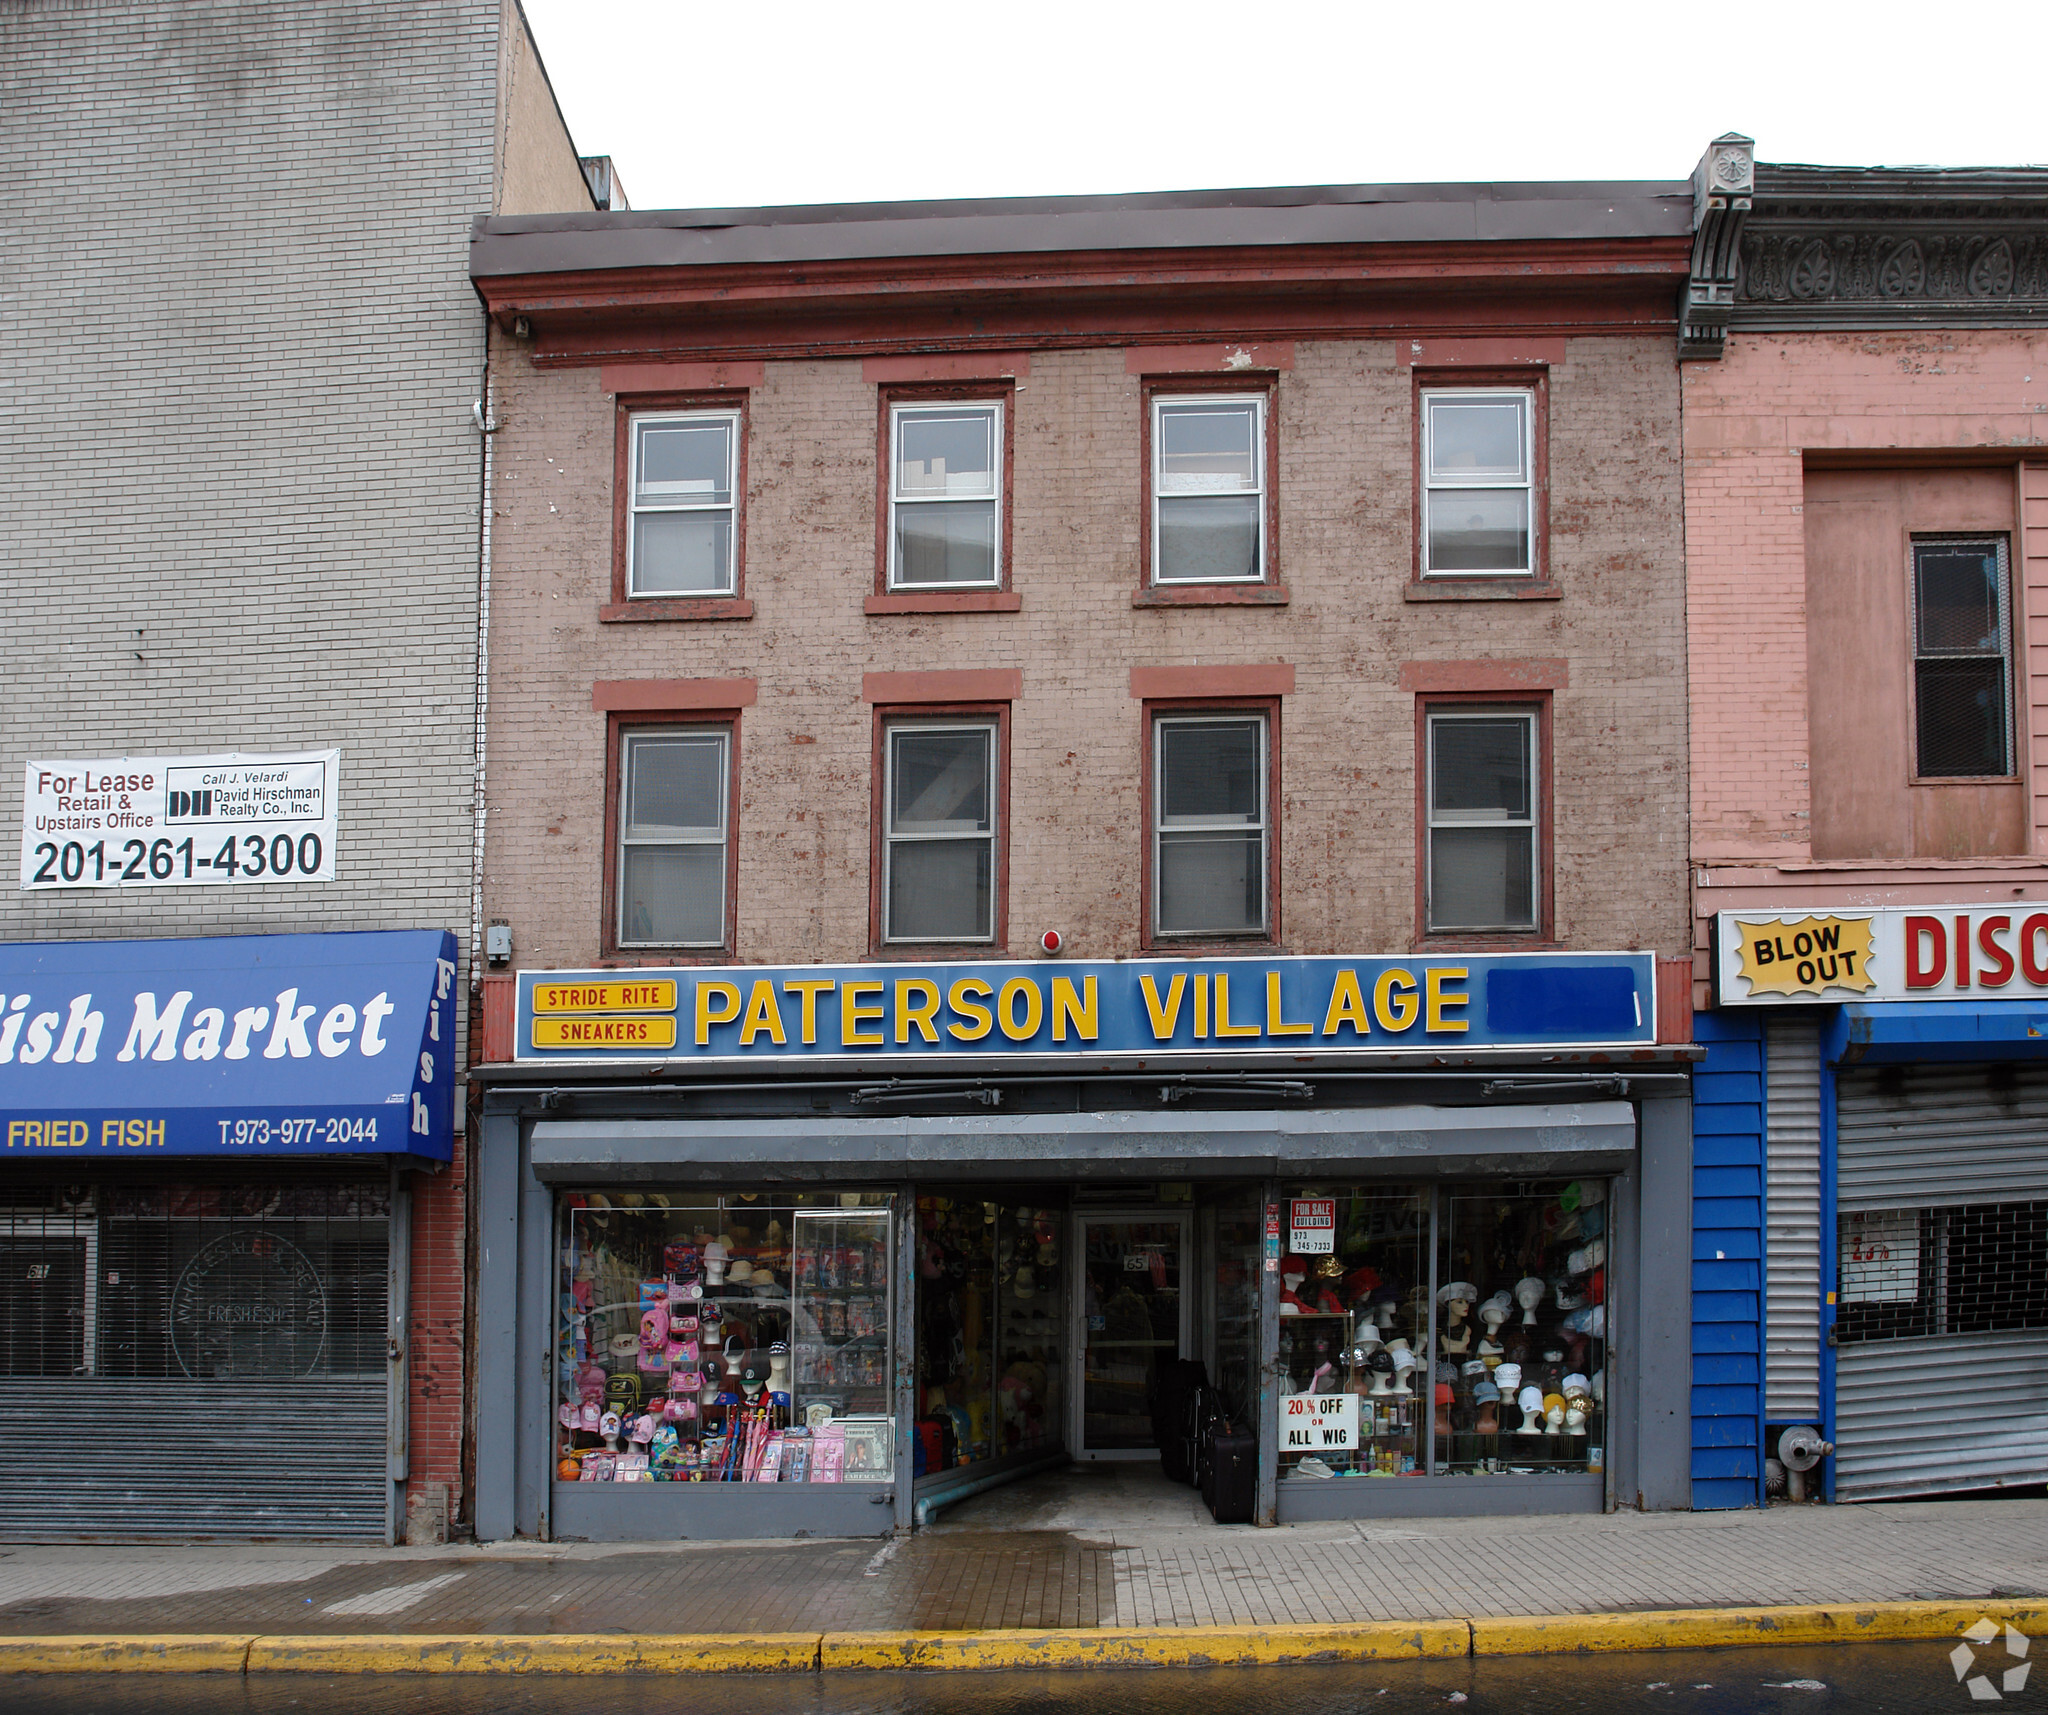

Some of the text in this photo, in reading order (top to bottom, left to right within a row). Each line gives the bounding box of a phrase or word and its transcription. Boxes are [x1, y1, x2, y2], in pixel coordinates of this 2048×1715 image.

[38, 771, 154, 794] For Lease
[202, 771, 289, 784] Call J. Velardi
[58, 794, 131, 811] Retail &
[214, 786, 320, 802] David Hirschman
[220, 801, 313, 817] Realty Co., Inc.
[35, 812, 154, 834] Upstairs Office
[33, 832, 323, 883] 201-261-4300
[1754, 924, 1840, 967] BLOW
[1796, 950, 1857, 985] OUT
[548, 987, 660, 1006] STRIDE RITE
[694, 966, 1470, 1047] PATERSON VILLAGE
[0, 987, 394, 1064] ish Market
[560, 1023, 647, 1040] SNEAKERS
[411, 958, 455, 1136] Fish
[8, 1119, 165, 1147] FRIED FISH
[218, 1118, 378, 1145] T.973-977-2044
[1295, 1203, 1331, 1216] FOR SALE
[1296, 1217, 1330, 1226] BUILDING
[1294, 1231, 1307, 1240] 973
[1297, 1242, 1331, 1250] 345-7333
[1127, 1258, 1143, 1270] 65
[1320, 1399, 1343, 1414] OFF
[1288, 1429, 1347, 1445] ALL WIG
